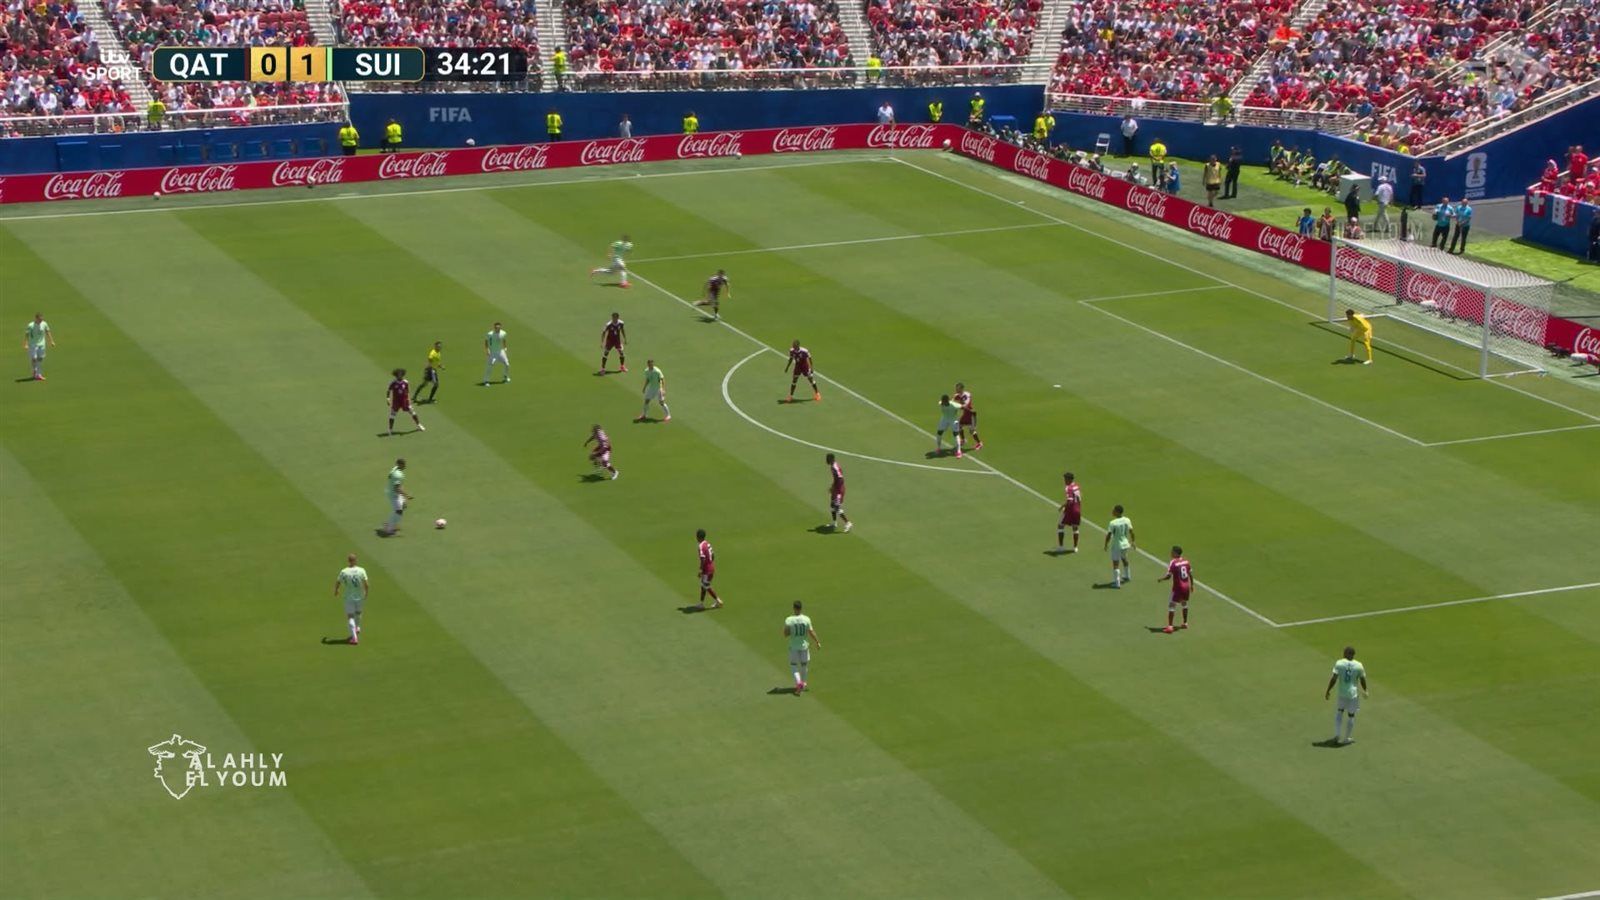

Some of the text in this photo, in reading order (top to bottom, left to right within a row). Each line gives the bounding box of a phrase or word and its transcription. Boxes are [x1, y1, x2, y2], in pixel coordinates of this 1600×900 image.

[429, 107, 472, 123] FIFA
[677, 131, 743, 158] Coca-Cola
[772, 127, 839, 152] Coca-Cola
[867, 125, 937, 148] Coca-Cola
[961, 130, 997, 162] Coca-Cola
[379, 151, 449, 179] Coca-Cola
[480, 144, 550, 172] Coca-Cola
[580, 138, 647, 165] Coca-Cola
[1014, 148, 1050, 180] Coca-Cola
[44, 171, 125, 200] Coca-Cola
[161, 164, 239, 193] Coca-Cola
[272, 158, 346, 186] Coca-Cola
[1068, 166, 1107, 199] Coca-Cola
[1371, 161, 1397, 184] FIFA
[1126, 185, 1168, 218] Coca-Cola
[1188, 205, 1234, 240] Coca-Cola
[1258, 226, 1305, 261] Coca-Cola
[1180, 565, 1188, 580] 8
[794, 622, 806, 637] 10
